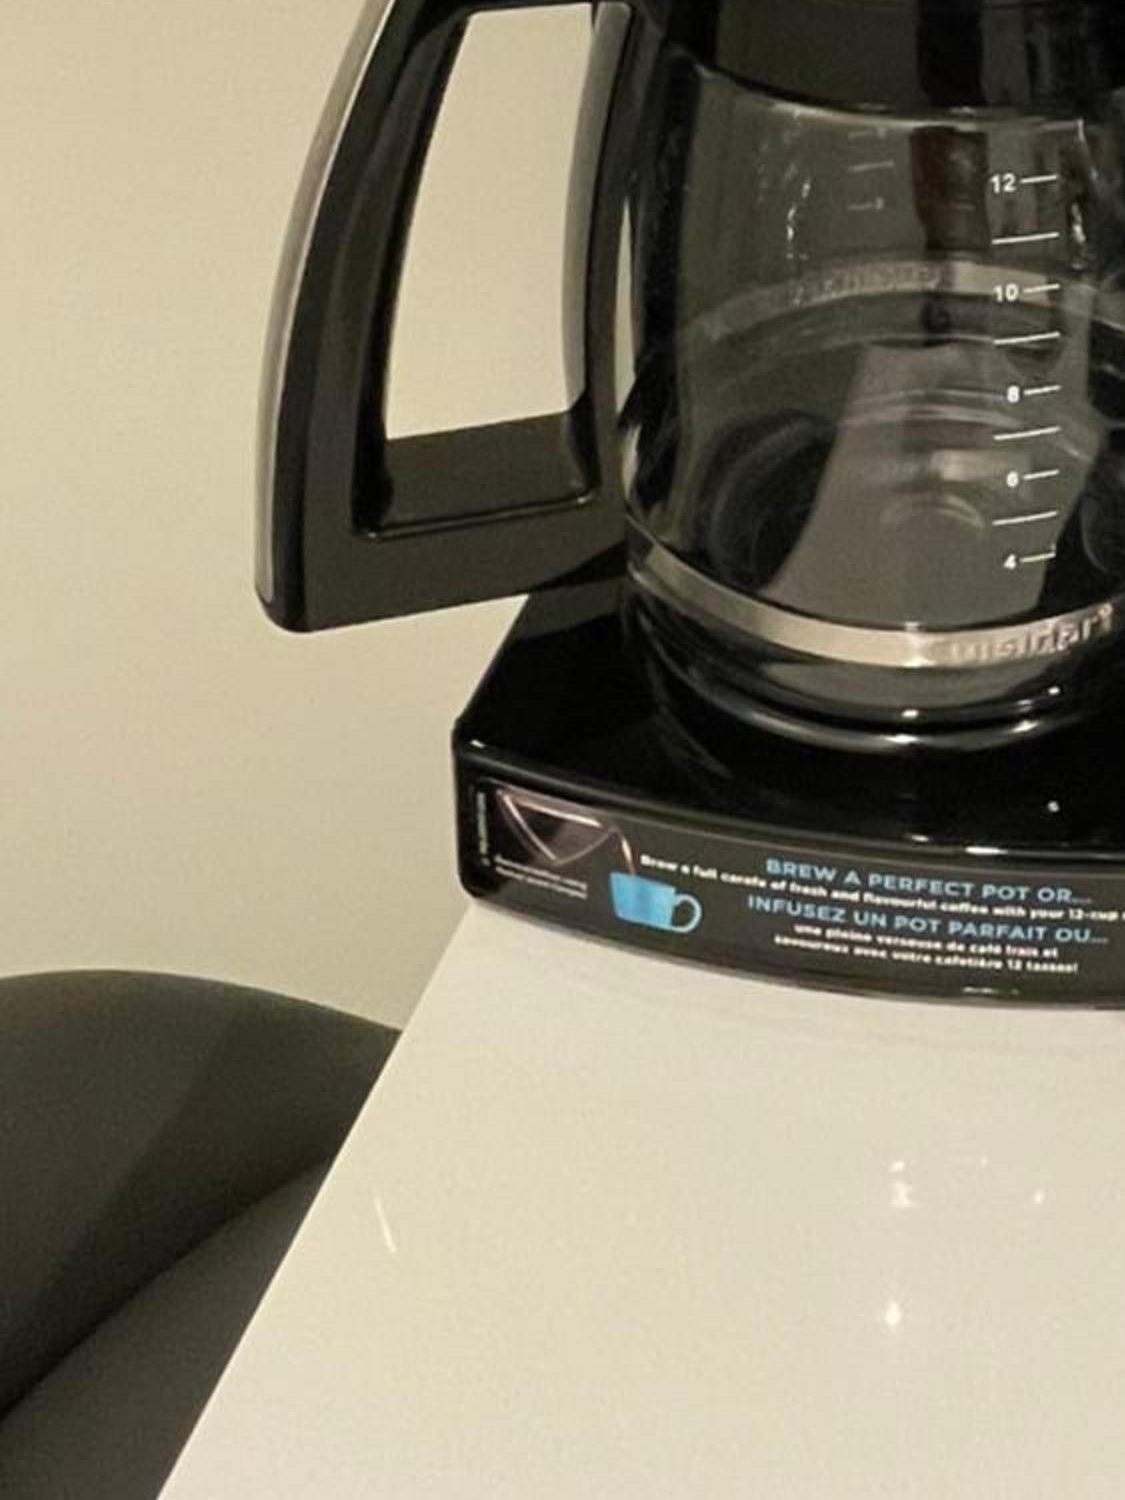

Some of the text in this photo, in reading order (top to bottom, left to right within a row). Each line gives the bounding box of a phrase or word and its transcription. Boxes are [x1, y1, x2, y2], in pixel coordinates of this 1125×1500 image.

[991, 173, 1016, 194] 12
[994, 283, 1018, 302] 10
[1006, 384, 1021, 404] 8
[1006, 469, 1019, 488] 6
[1003, 553, 1017, 570] 4
[640, 853, 679, 873] Brew
[692, 864, 718, 881] full
[719, 871, 768, 889] carafe
[769, 878, 787, 892] of
[788, 881, 828, 898] fresh
[830, 888, 861, 902] and
[939, 901, 990, 916] coffee
[991, 905, 1027, 918] with
[1029, 908, 1065, 921] your
[1068, 907, 1120, 923] 12-cup
[766, 857, 837, 882] BREW
[843, 868, 862, 886] A
[868, 873, 975, 899] PERFECT
[981, 883, 1031, 901] POT
[747, 894, 848, 924] INFUSEZ
[853, 909, 888, 929] UN
[894, 914, 942, 934] POT
[948, 920, 1049, 942] PARFAIT
[1006, 958, 1023, 972] 12
